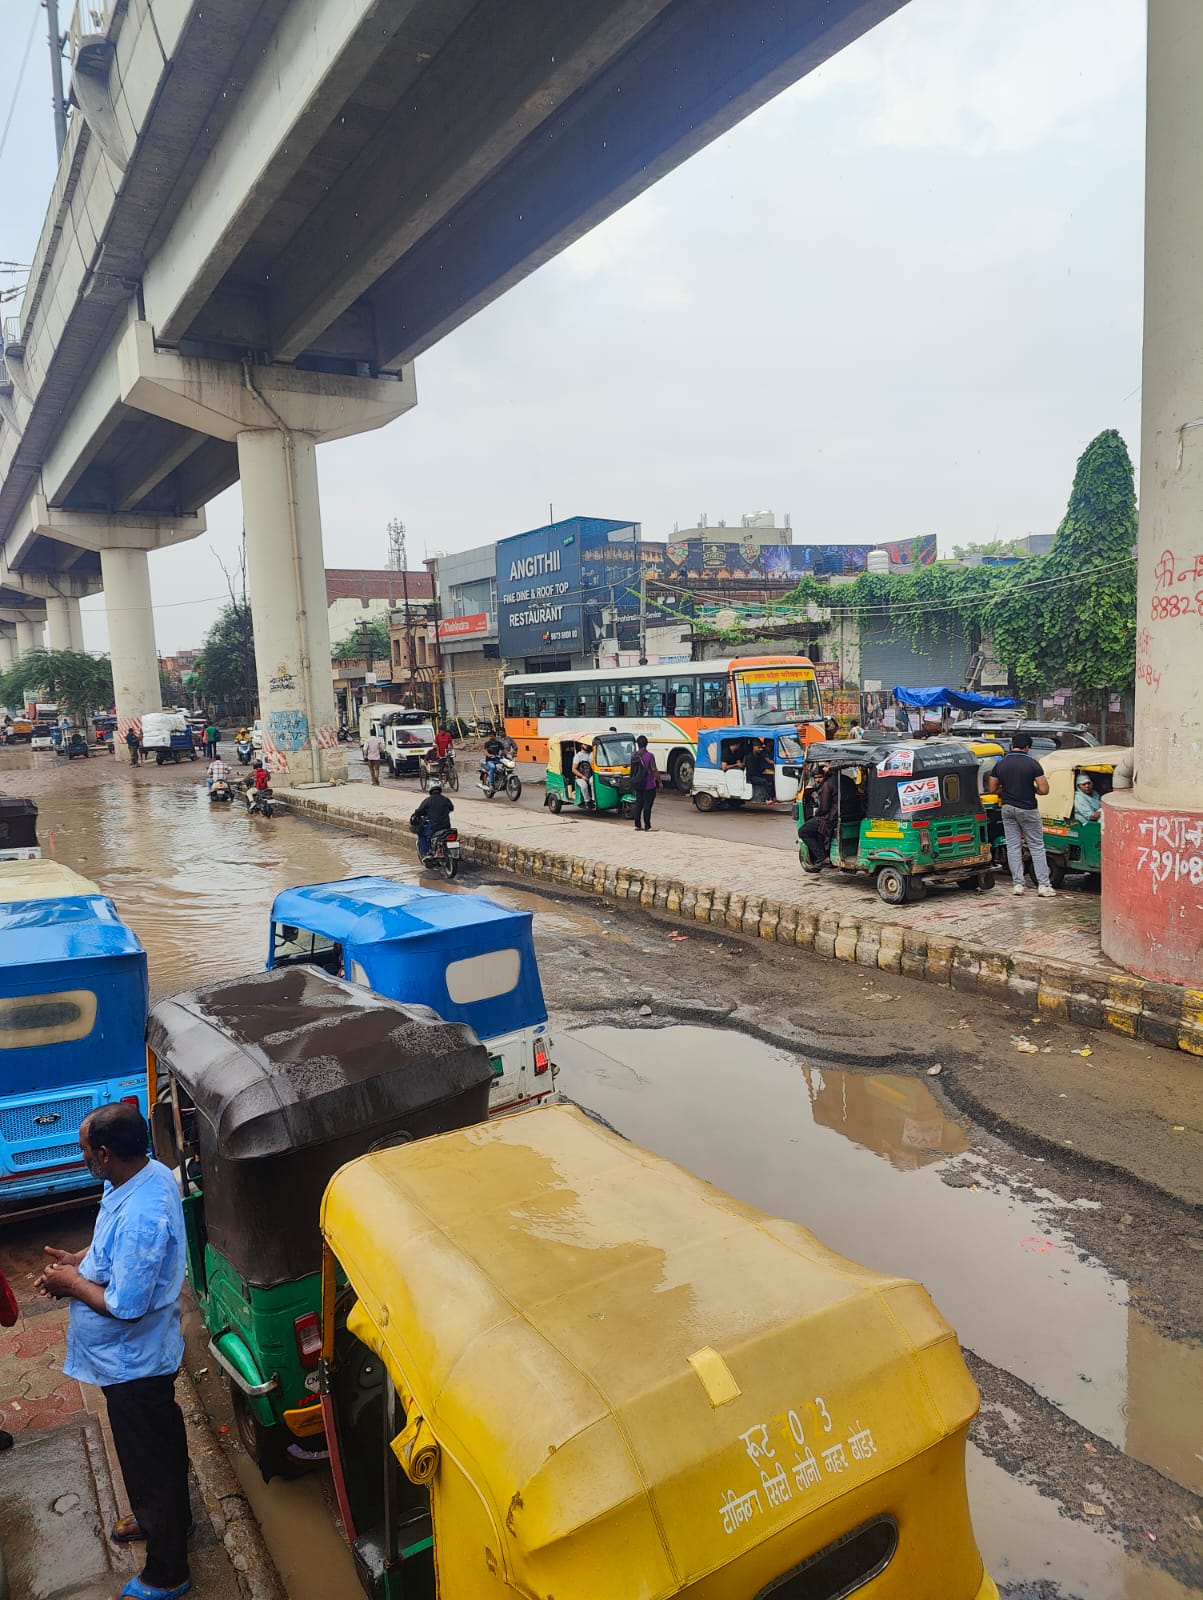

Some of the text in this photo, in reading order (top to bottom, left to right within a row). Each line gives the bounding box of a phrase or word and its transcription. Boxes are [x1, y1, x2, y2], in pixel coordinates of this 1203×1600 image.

[510, 550, 560, 581] ANGITHII
[536, 585, 554, 598] ROOF
[555, 582, 569, 595] TOP
[510, 606, 562, 627] RESTAURANT
[903, 781, 936, 793] AVS
[760, 1462, 793, 1508] सिटी
[792, 1446, 822, 1492] लोनी
[820, 1442, 849, 1474] नहर
